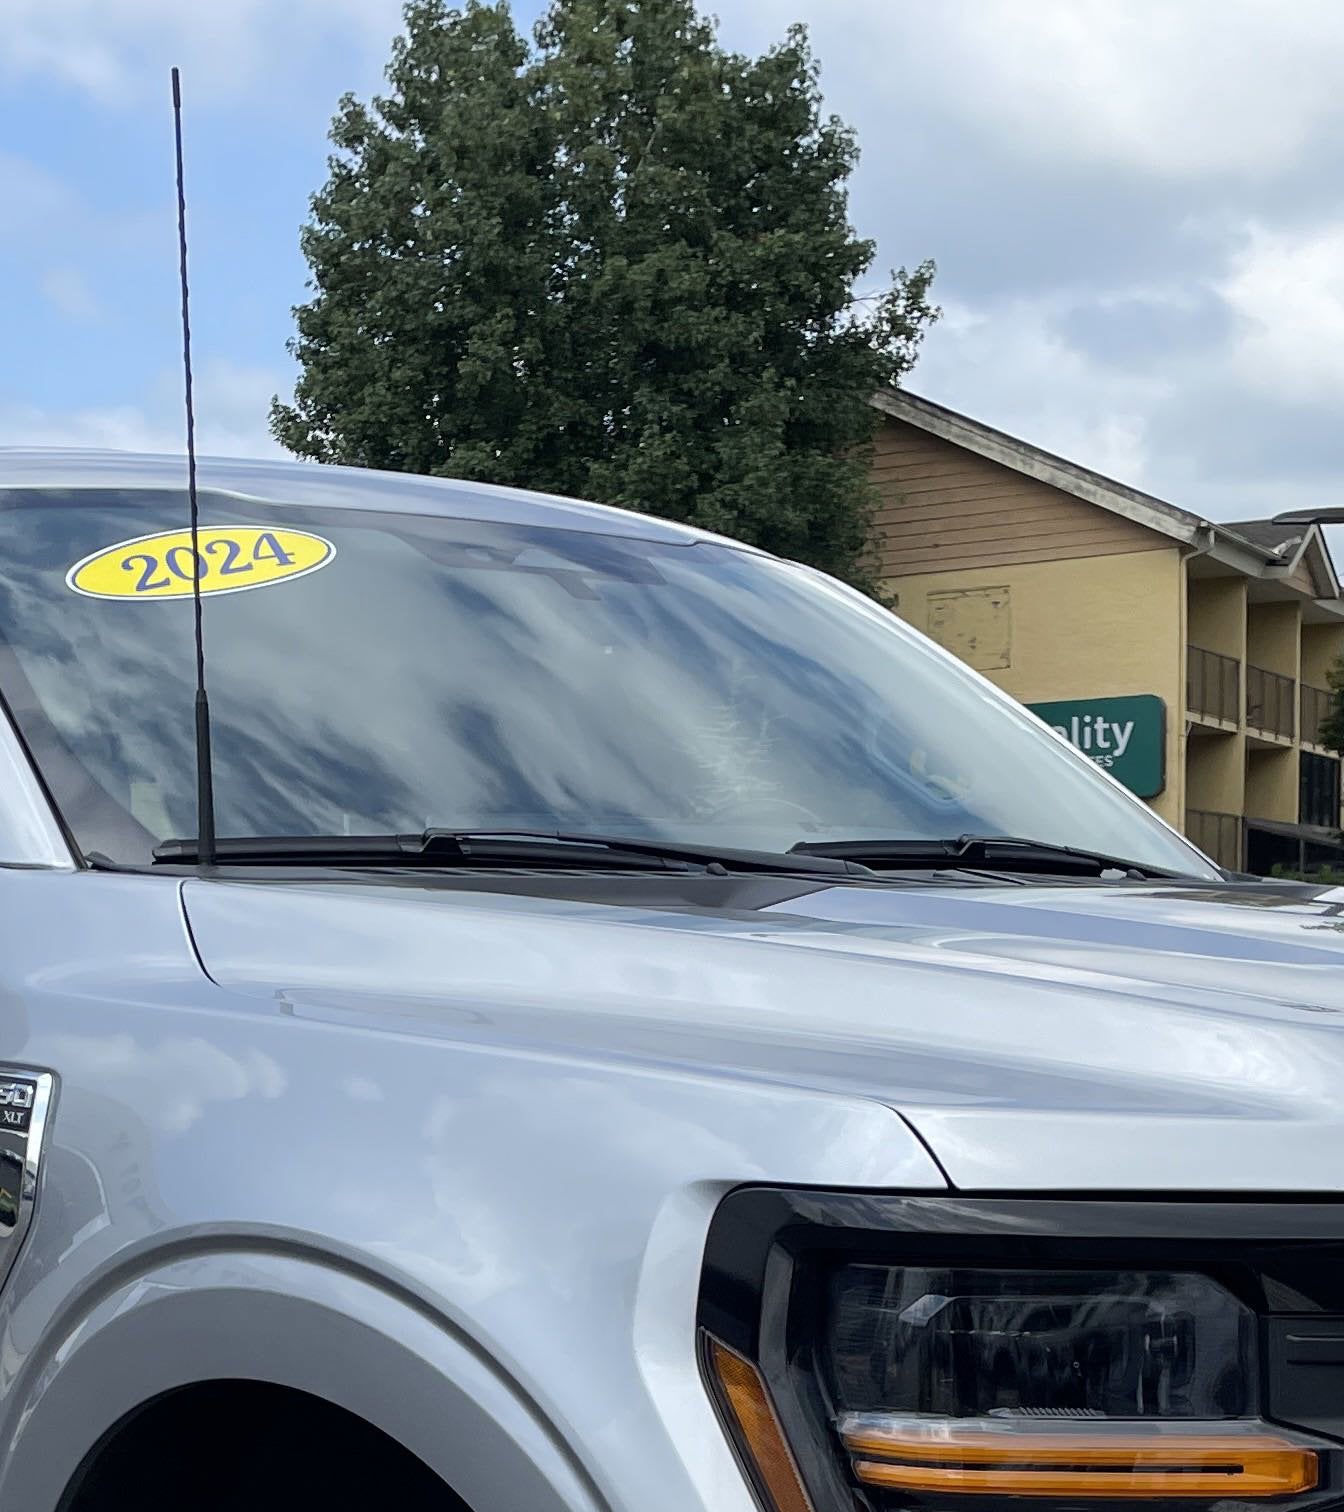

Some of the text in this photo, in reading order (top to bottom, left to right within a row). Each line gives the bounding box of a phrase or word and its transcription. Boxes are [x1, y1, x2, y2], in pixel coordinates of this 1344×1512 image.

[121, 532, 295, 592] 2024
[1052, 715, 1134, 757] lity
[2, 1110, 25, 1124] XLT
